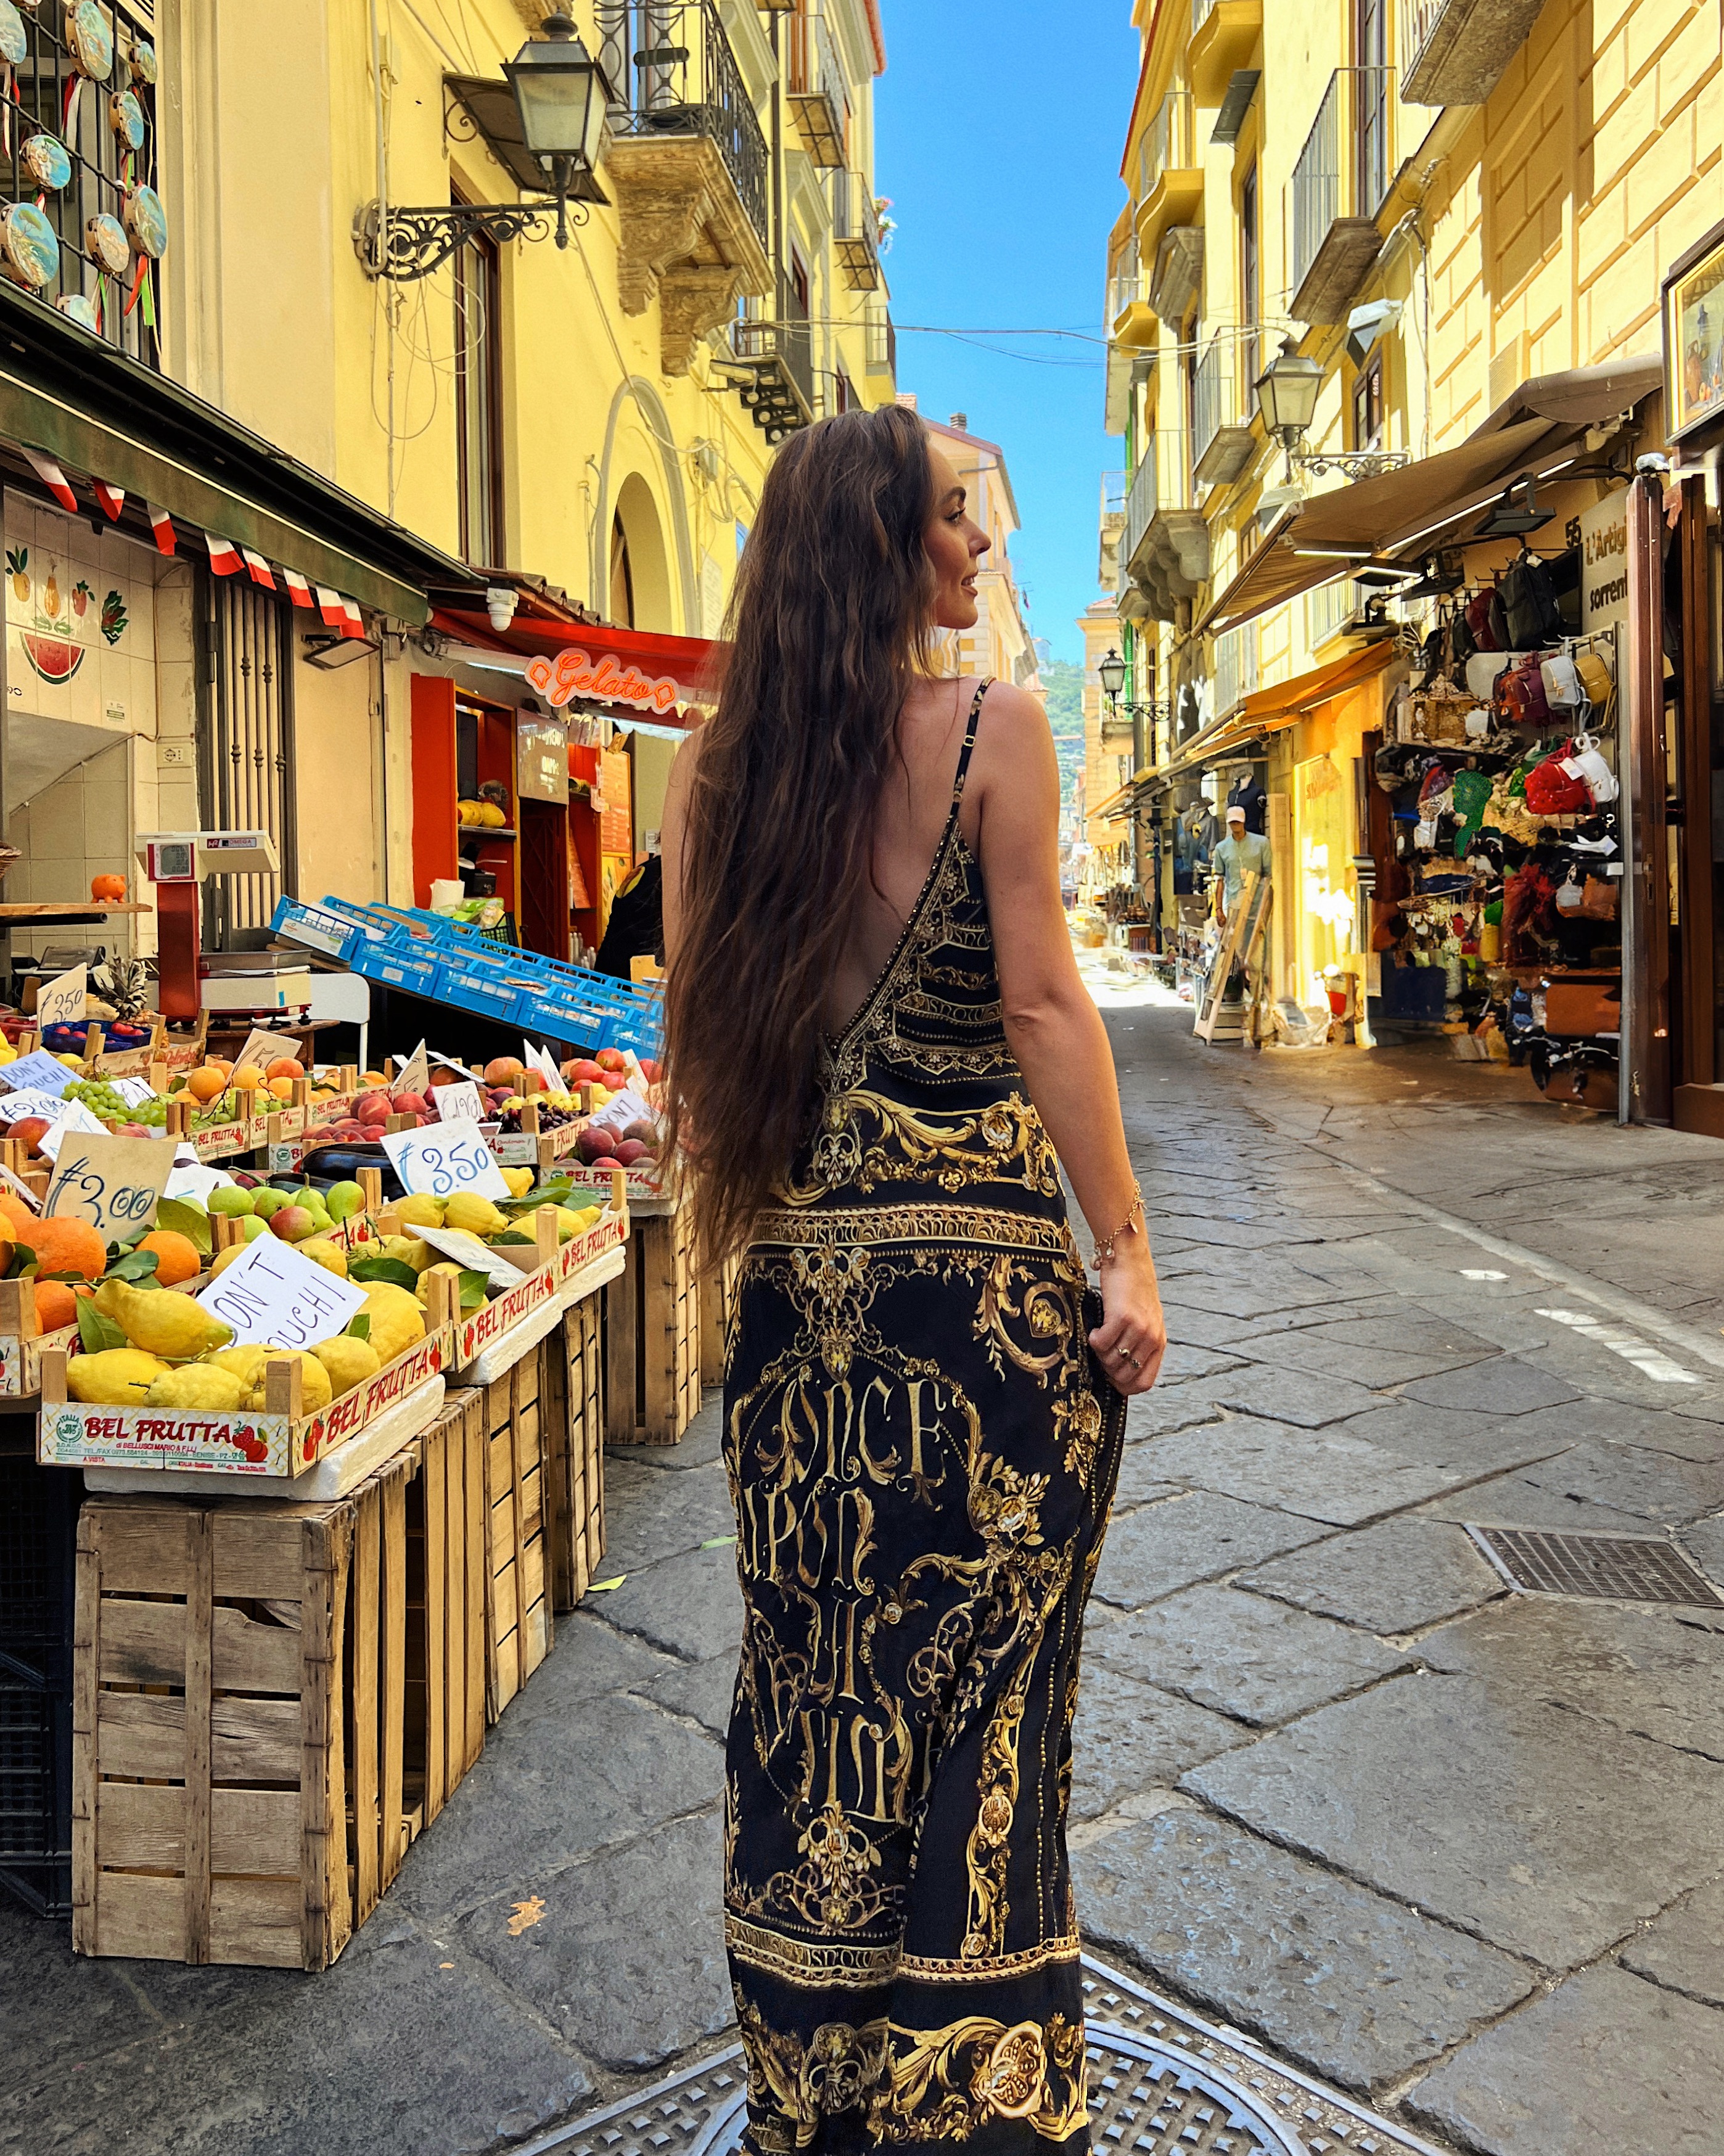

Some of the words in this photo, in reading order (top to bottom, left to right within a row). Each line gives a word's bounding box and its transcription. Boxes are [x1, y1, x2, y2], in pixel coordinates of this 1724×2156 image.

[551, 652, 652, 706] Gelato
[571, 1238, 586, 1269] BEL
[587, 1221, 617, 1260] FRUTTA
[476, 1305, 498, 1345] BEL
[501, 1273, 544, 1329] FRUTTA
[326, 1391, 361, 1445] BEL
[365, 1346, 427, 1422] FRUTTA
[84, 1417, 129, 1439] BEL
[135, 1419, 232, 1443] FRUTTA
